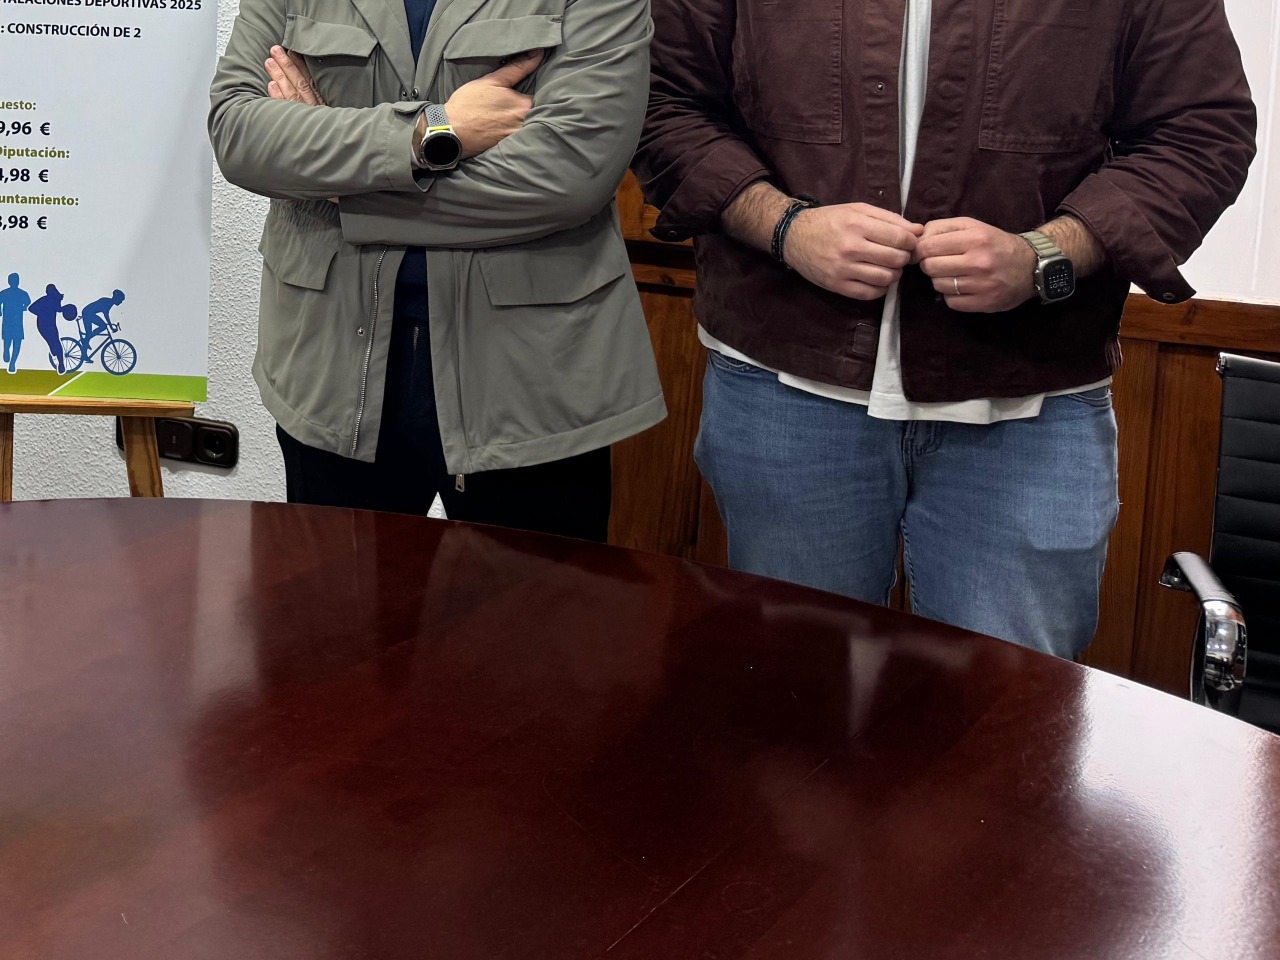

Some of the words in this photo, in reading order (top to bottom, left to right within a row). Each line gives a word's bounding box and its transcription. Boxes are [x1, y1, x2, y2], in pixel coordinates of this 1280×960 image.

[170, 0, 201, 10] 2025
[7, 23, 110, 37] CONSTRUCCIÓN
[113, 26, 130, 38] DE
[133, 27, 141, 38] 2
[40, 122, 50, 136] €
[38, 169, 49, 183] €
[36, 216, 47, 230] €
